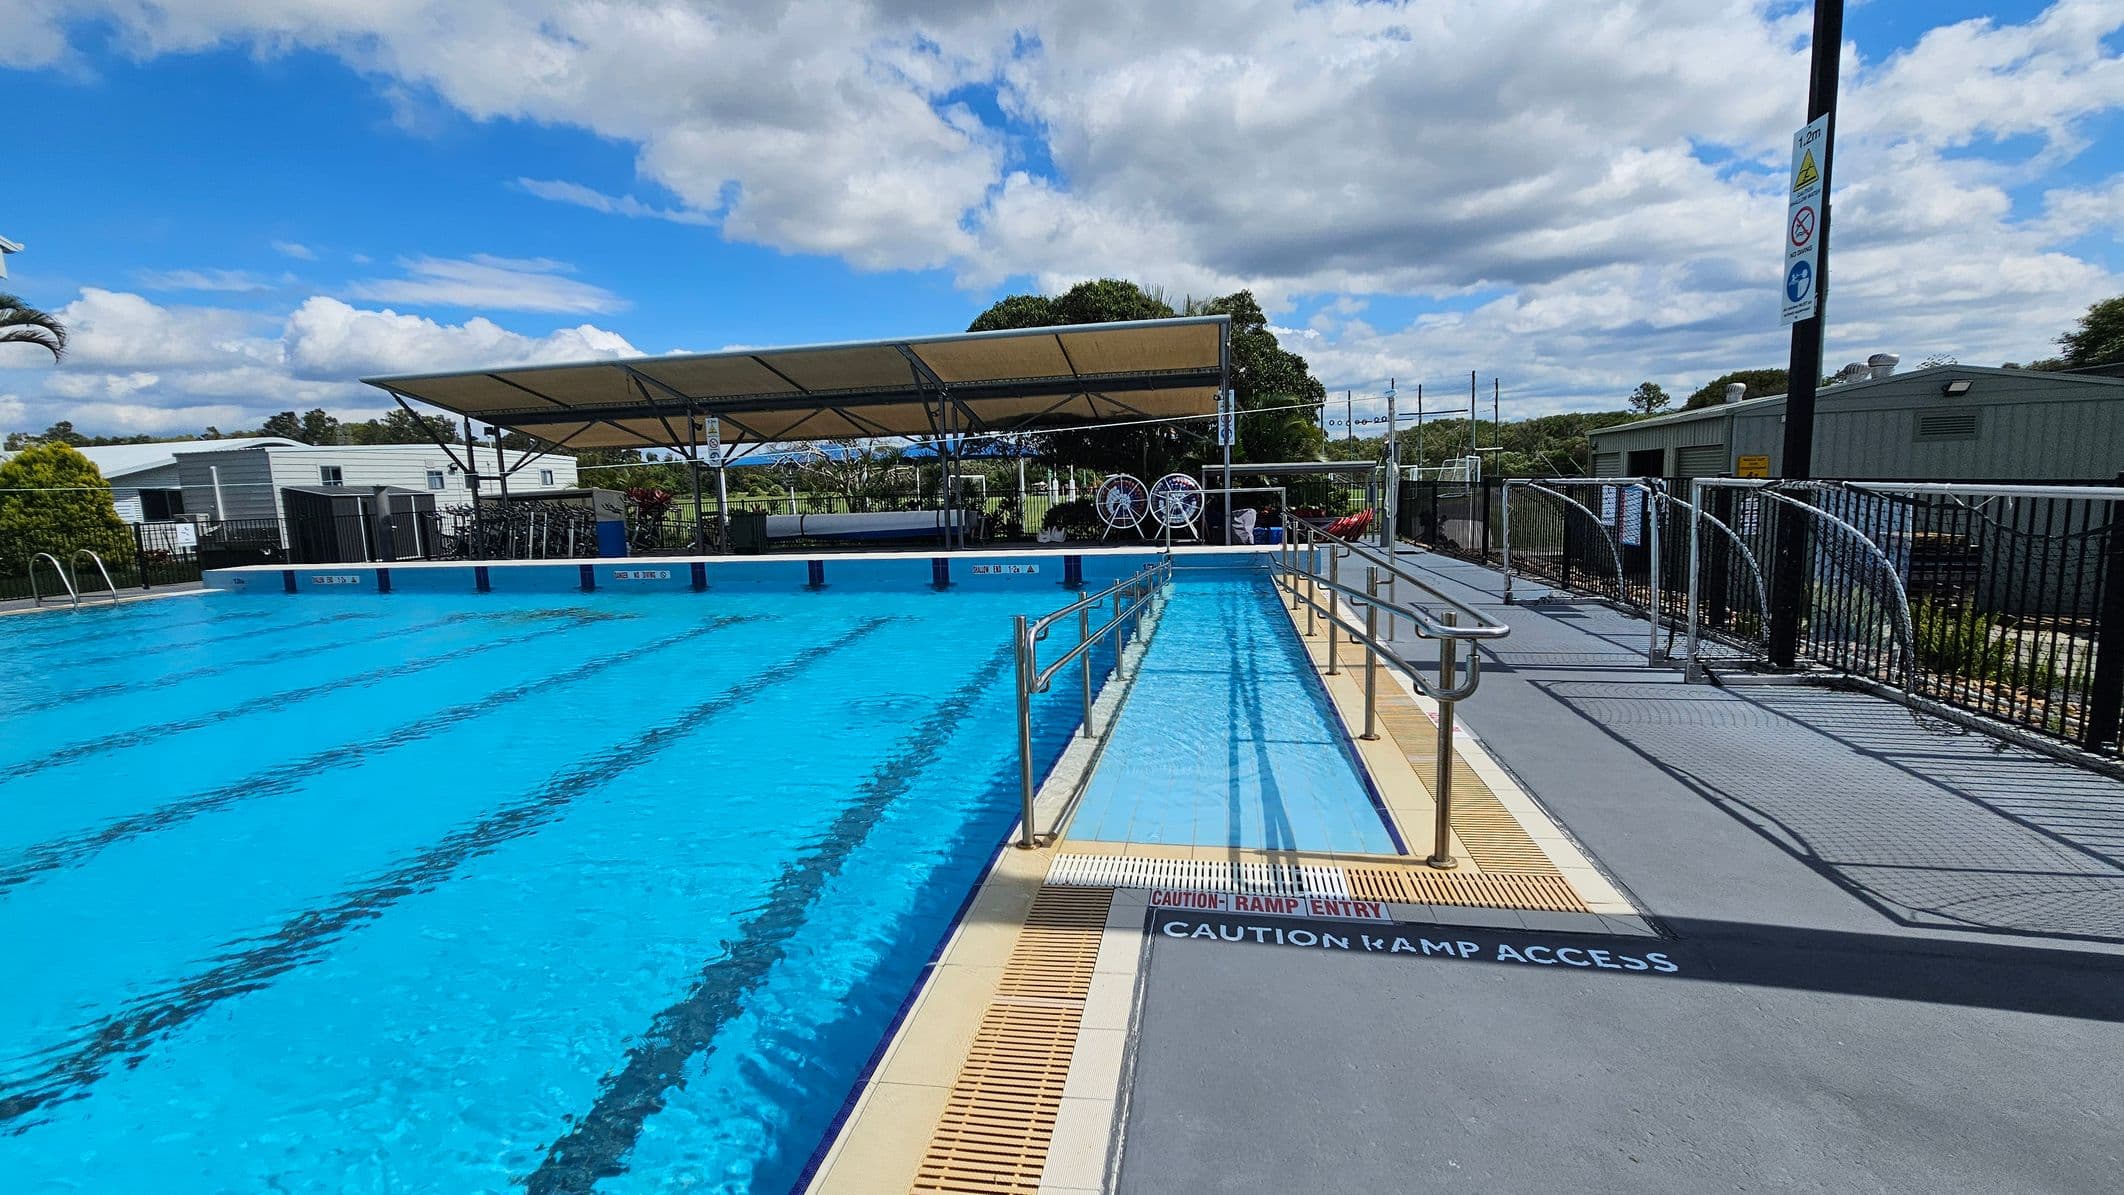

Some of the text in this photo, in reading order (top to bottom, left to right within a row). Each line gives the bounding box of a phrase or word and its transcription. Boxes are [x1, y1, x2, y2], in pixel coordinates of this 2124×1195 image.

[1798, 128, 1821, 148] 1.2m
[1796, 245, 1813, 257] DIVING
[1151, 890, 1382, 919] CAUTION- RAMP ENTRY
[1163, 921, 1680, 973] CAUTION RAMP ACCESS
